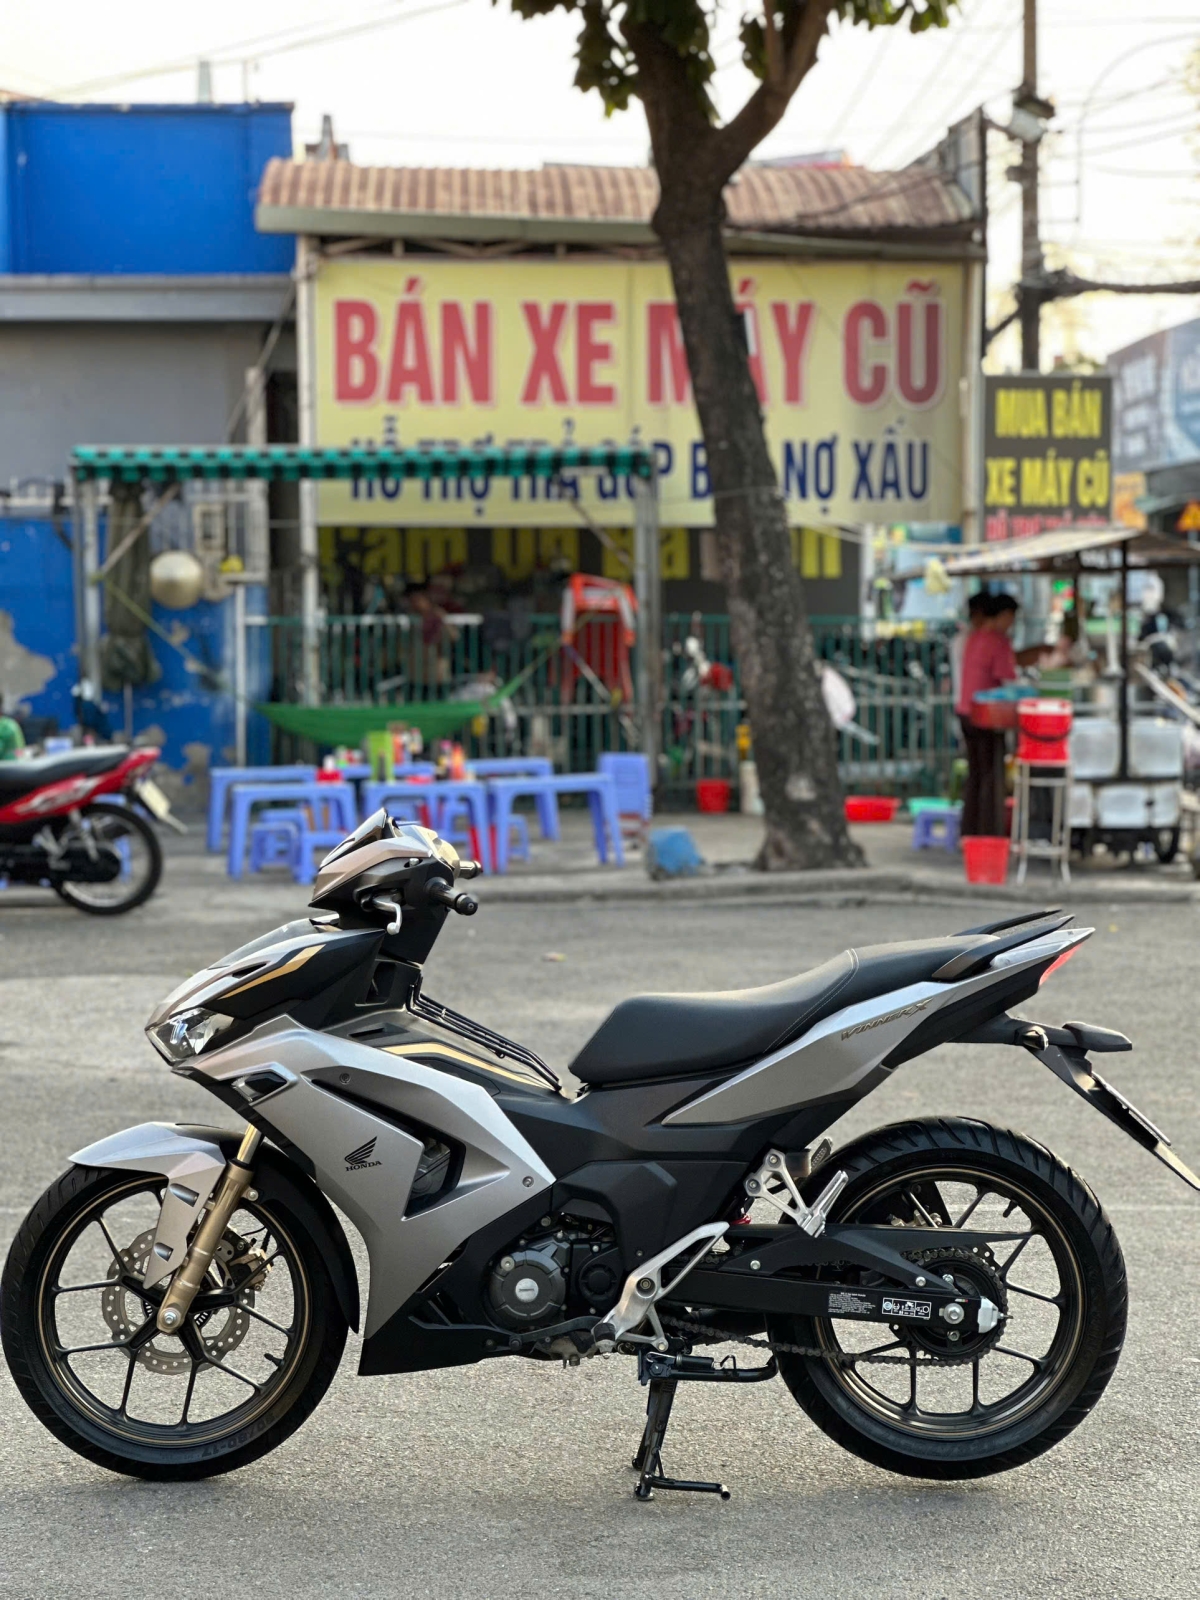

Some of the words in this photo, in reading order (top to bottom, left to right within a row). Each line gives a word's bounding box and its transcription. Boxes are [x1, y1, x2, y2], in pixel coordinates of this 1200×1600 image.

[333, 275, 494, 405] BÁN
[521, 300, 618, 405] XE
[843, 278, 942, 407] CŨ
[994, 388, 1048, 439] MUA
[1051, 379, 1103, 439] BÁN
[985, 457, 1018, 507] XE
[1020, 447, 1074, 507] MÁY
[1075, 449, 1110, 508] CŨ
[345, 1160, 382, 1171] HONDA
